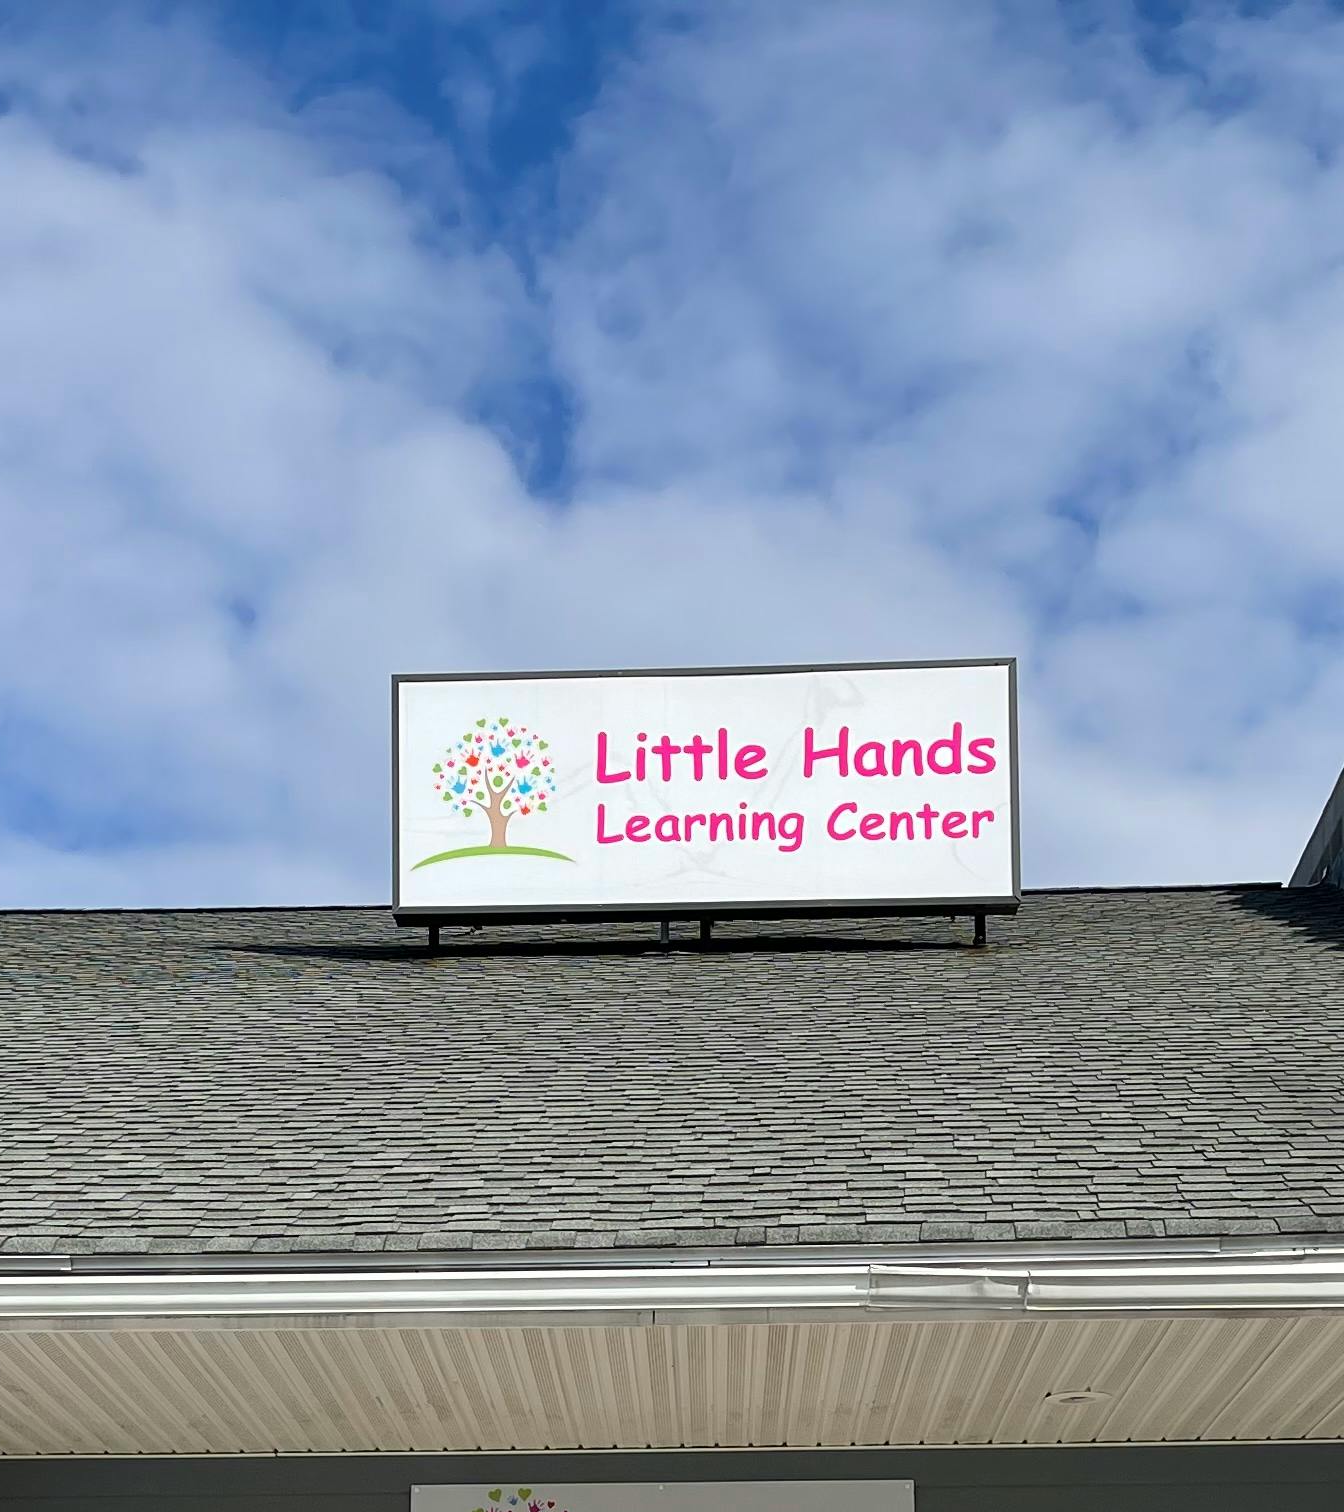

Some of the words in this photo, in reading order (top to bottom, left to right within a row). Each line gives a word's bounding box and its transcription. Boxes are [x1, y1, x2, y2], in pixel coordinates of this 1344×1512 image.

[596, 727, 768, 784] Little
[803, 721, 997, 778] Hands
[596, 802, 805, 853] Learning
[826, 802, 995, 842] Center
